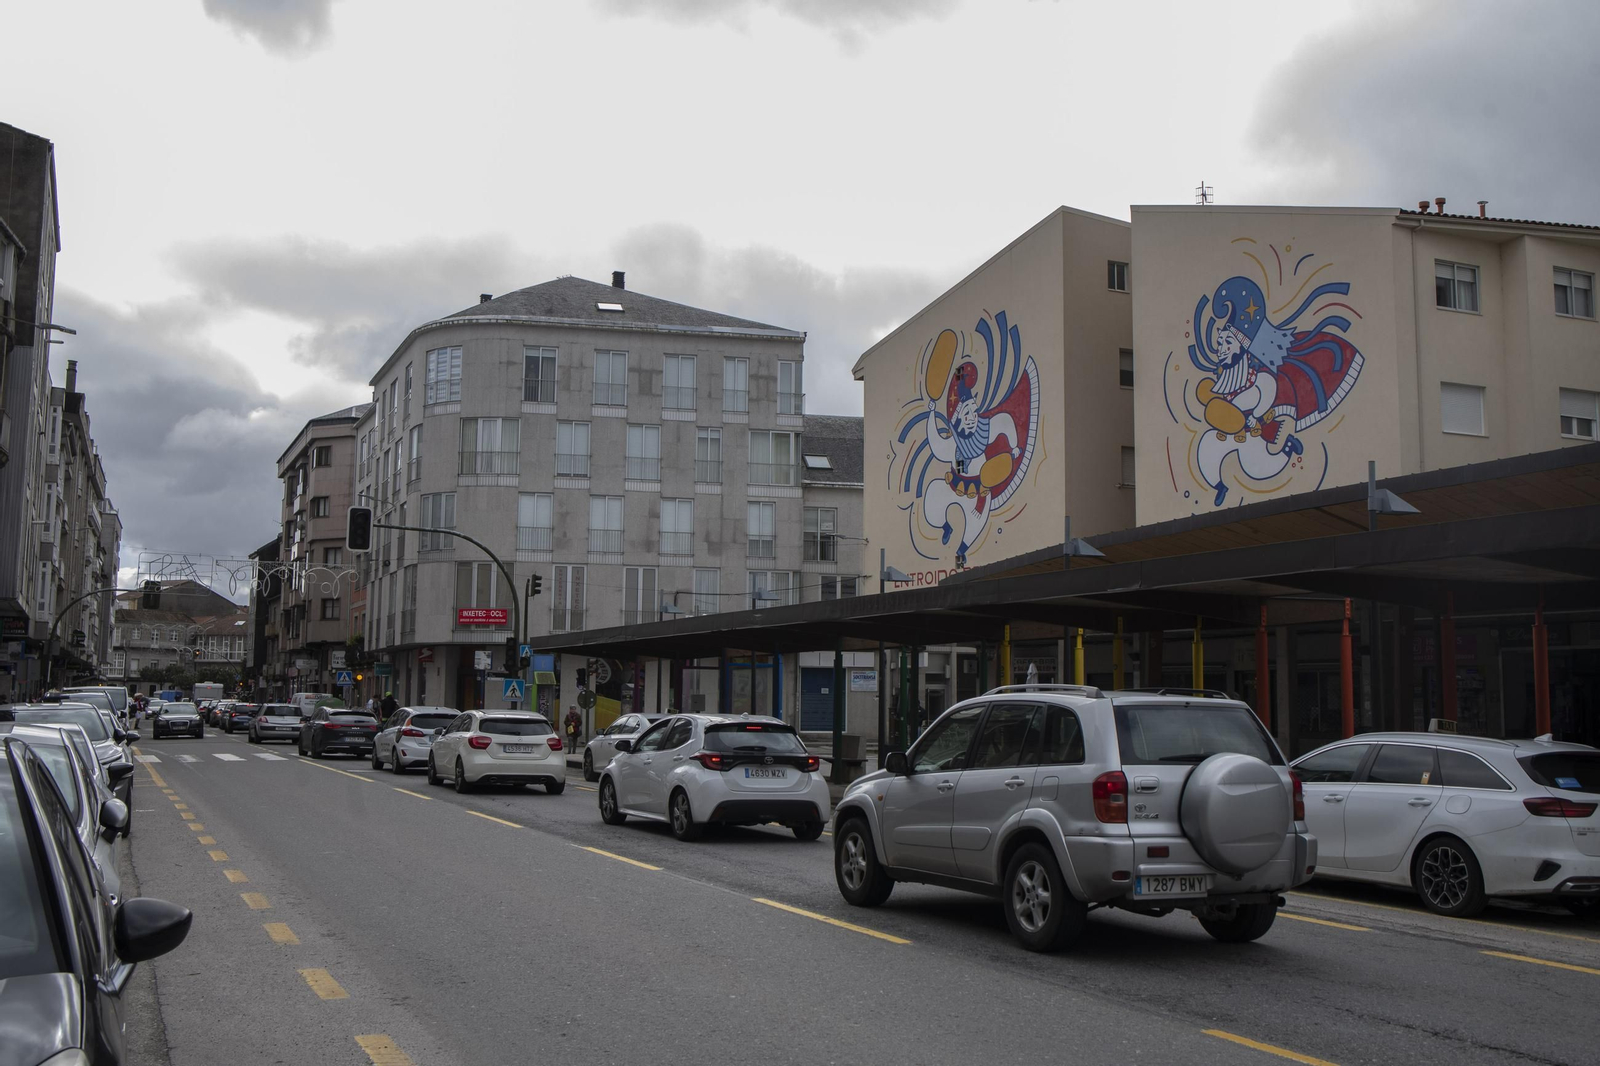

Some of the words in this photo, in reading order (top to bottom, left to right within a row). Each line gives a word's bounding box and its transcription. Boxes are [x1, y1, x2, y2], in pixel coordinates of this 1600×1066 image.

[462, 610, 487, 618] INXETEC
[490, 610, 503, 618] OCL
[750, 769, 770, 778] 4630
[771, 769, 786, 778] MZV
[1146, 877, 1175, 892] 1287
[1180, 877, 1204, 892] BMY
